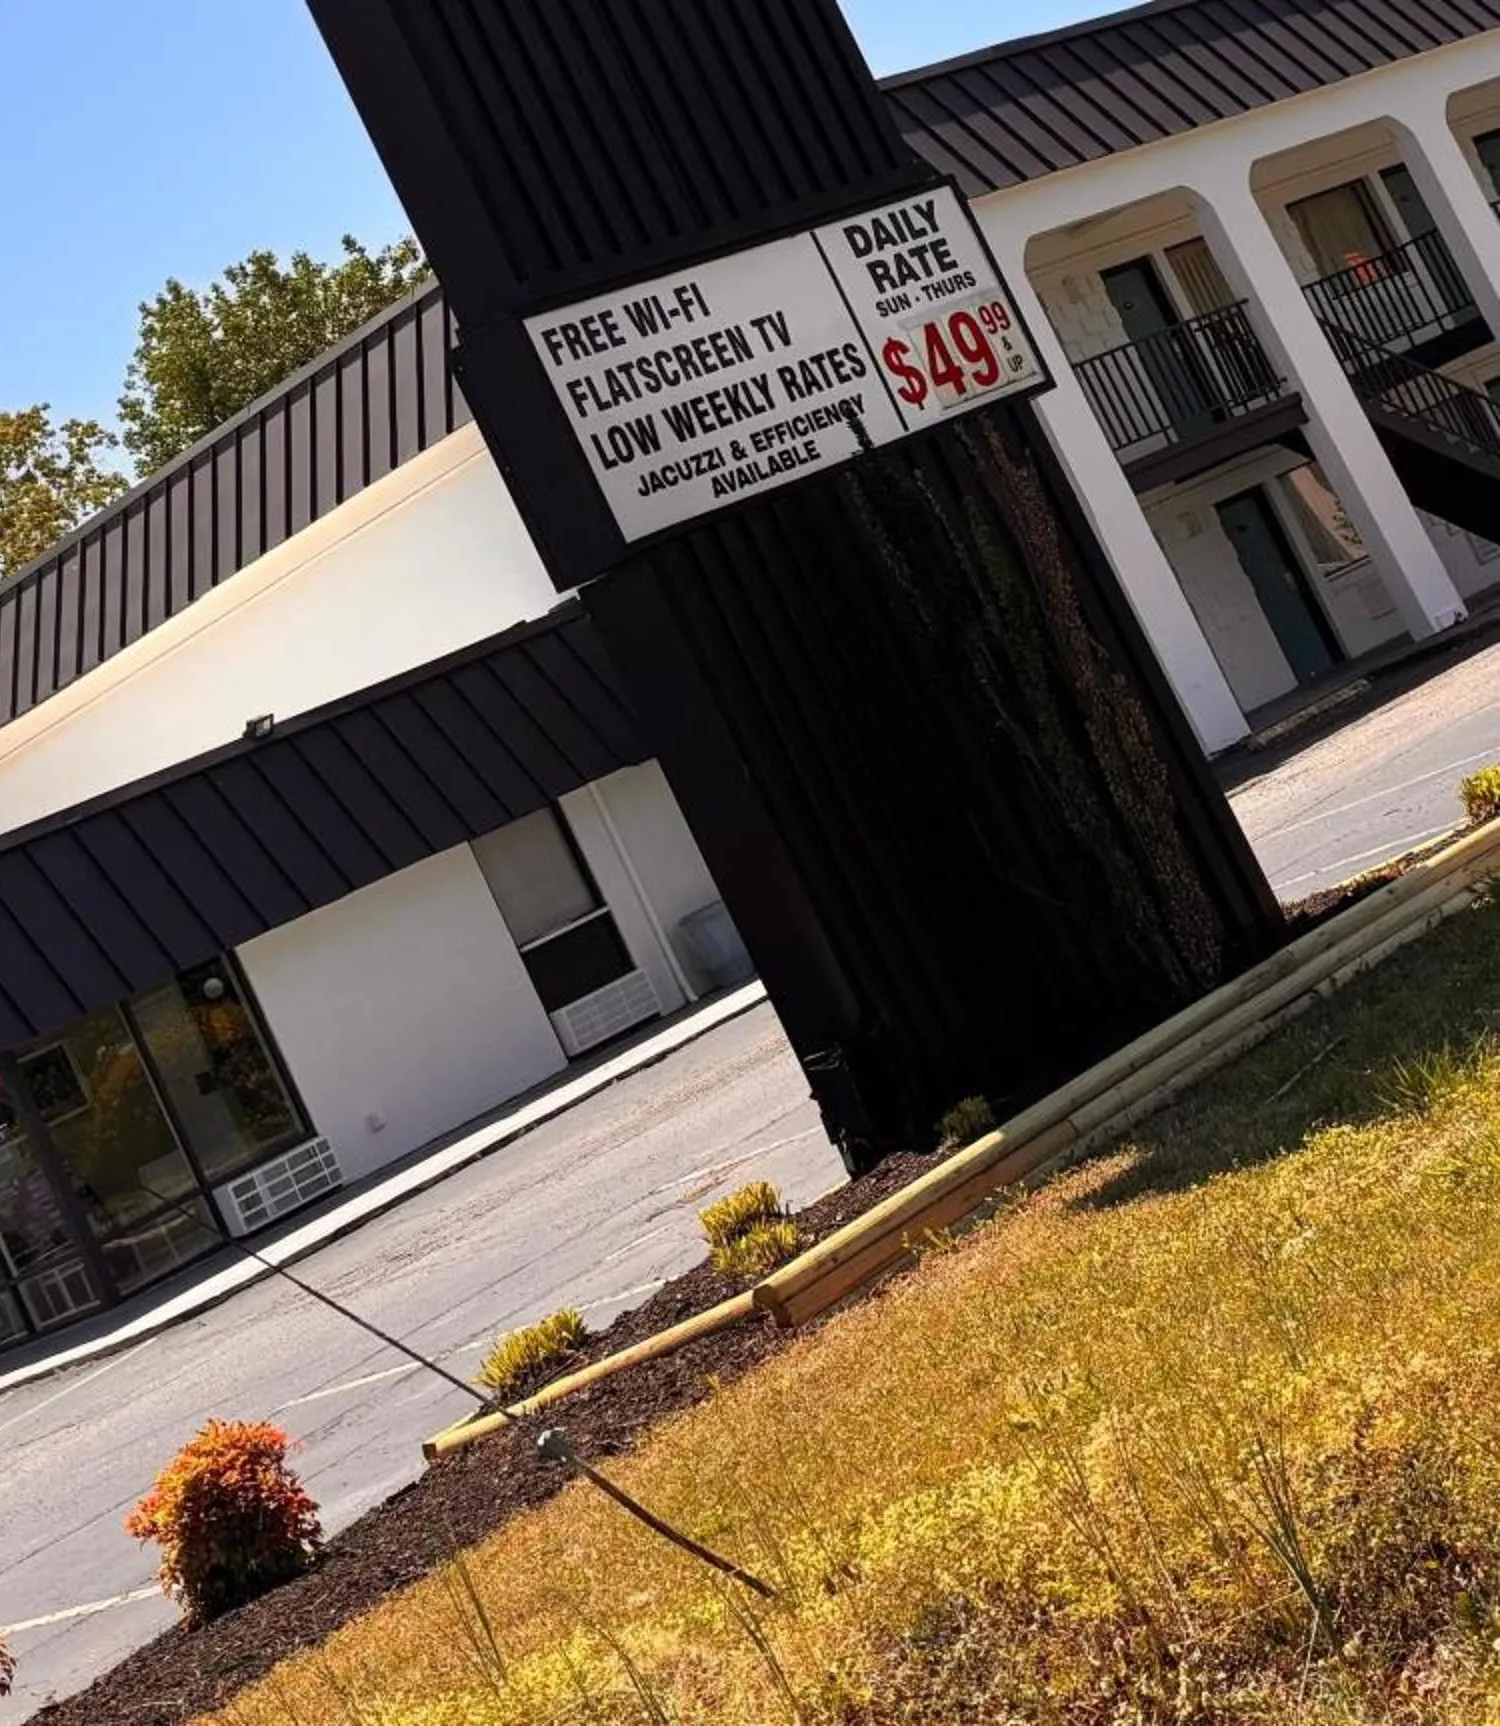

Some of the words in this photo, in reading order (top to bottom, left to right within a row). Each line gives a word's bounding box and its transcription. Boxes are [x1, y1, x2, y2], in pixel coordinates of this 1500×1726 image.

[843, 200, 940, 258] DAILY
[866, 237, 959, 295] RATE
[876, 292, 911, 317] SUN
[921, 271, 977, 303] THURS
[541, 309, 627, 367] FREE
[623, 282, 711, 338] WI-FI
[566, 324, 755, 418] FLATSCREEN
[750, 310, 792, 353] TV
[1007, 354, 1024, 373] UP
[590, 414, 662, 470] LOW
[661, 373, 776, 443] WEEKLY
[776, 343, 868, 403] RATES
[637, 447, 726, 497] JACUZZI
[730, 439, 748, 461] &
[710, 440, 821, 498] AVAILABLE
